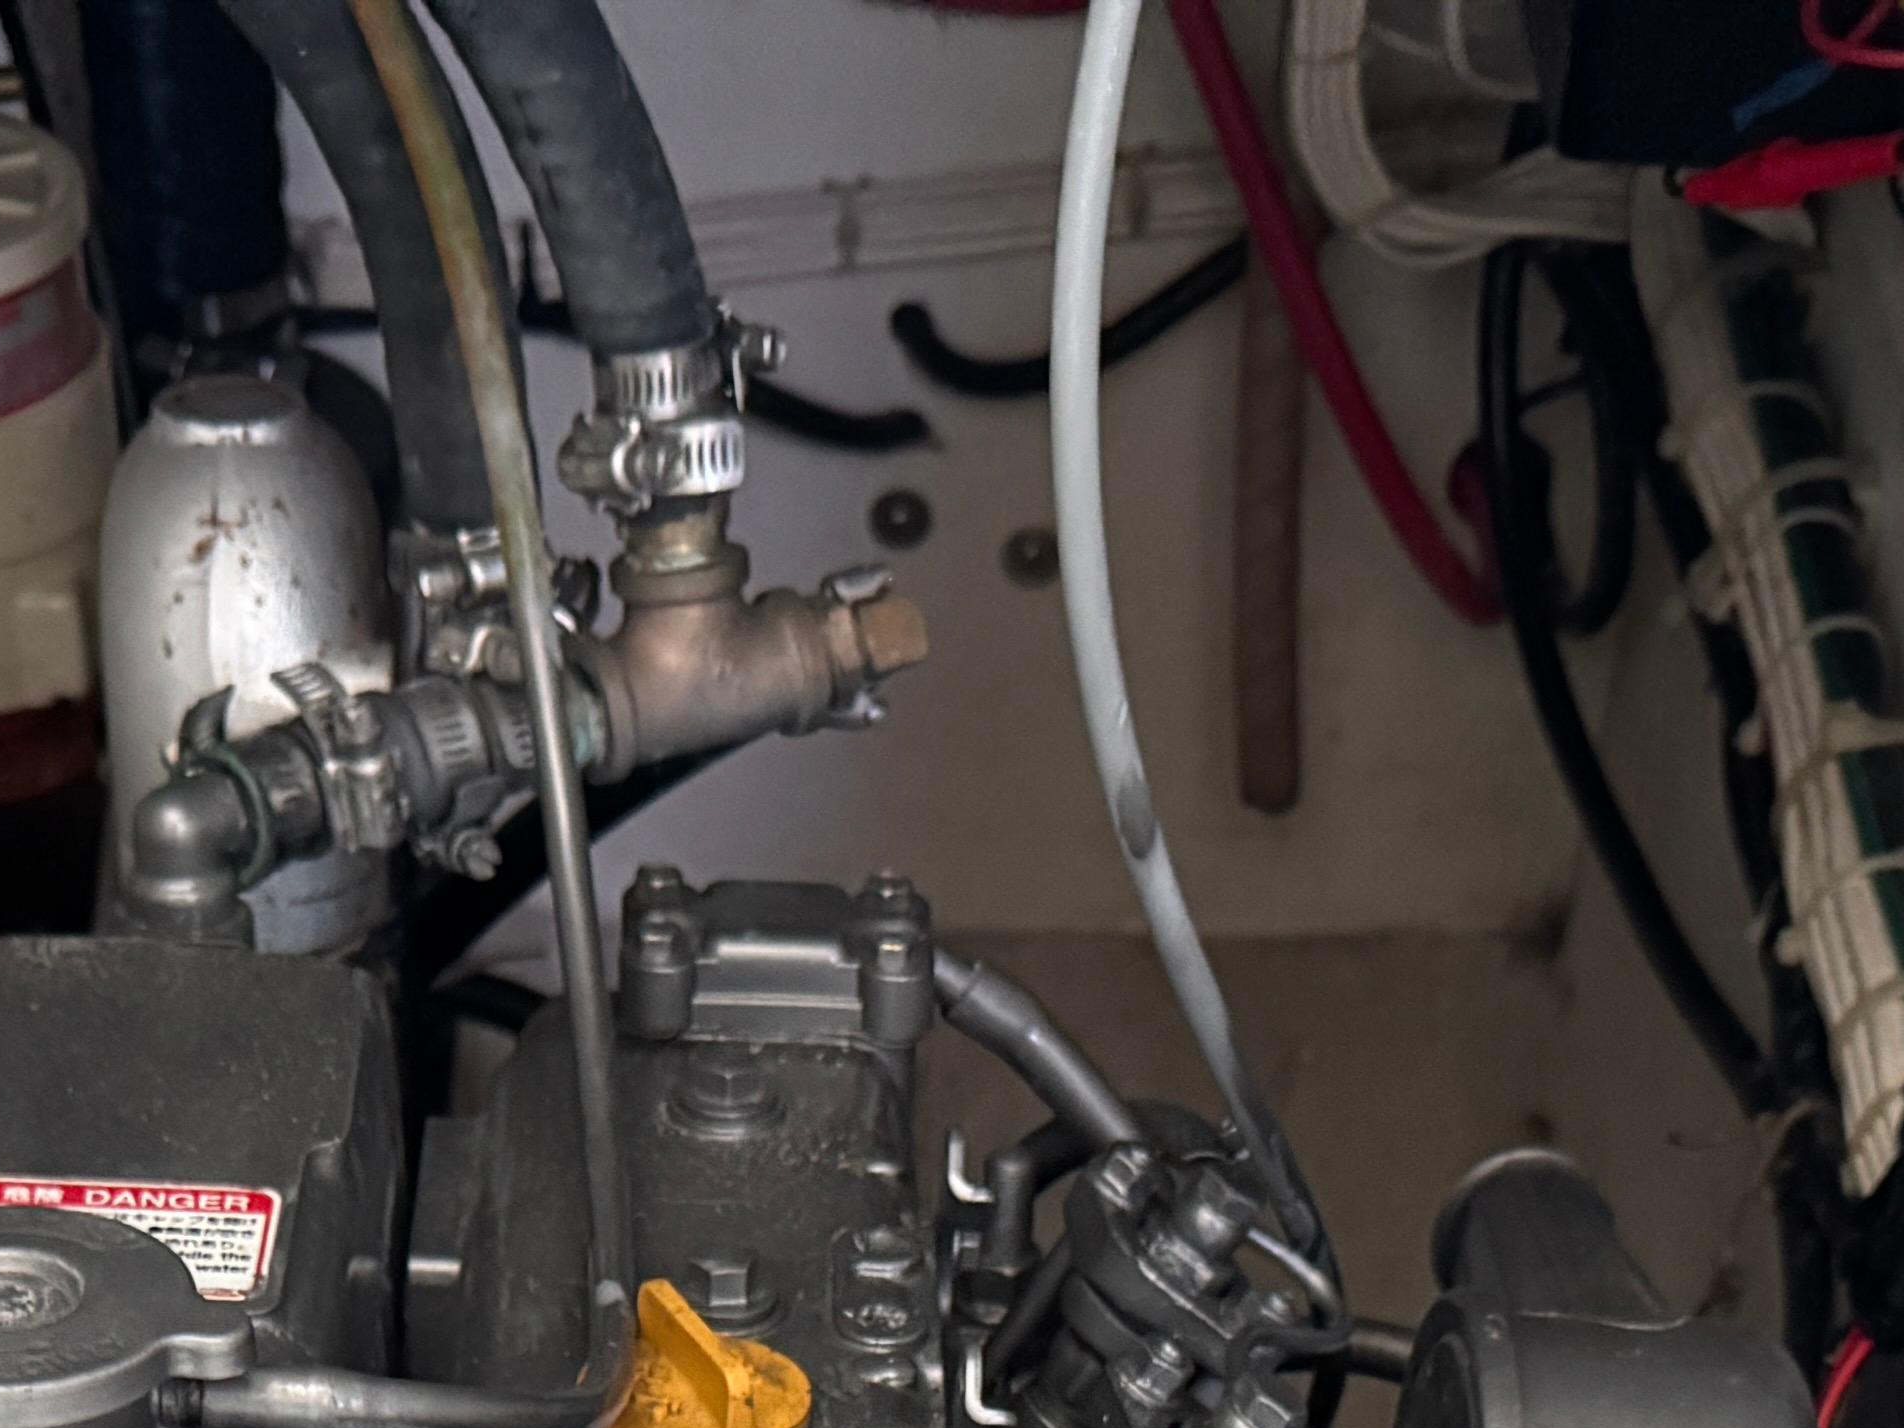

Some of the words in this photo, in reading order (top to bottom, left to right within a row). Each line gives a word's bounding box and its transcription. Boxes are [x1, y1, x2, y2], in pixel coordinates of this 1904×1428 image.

[85, 1188, 250, 1212] DANGER
[221, 1252, 251, 1261] the
[195, 1264, 248, 1273] water
